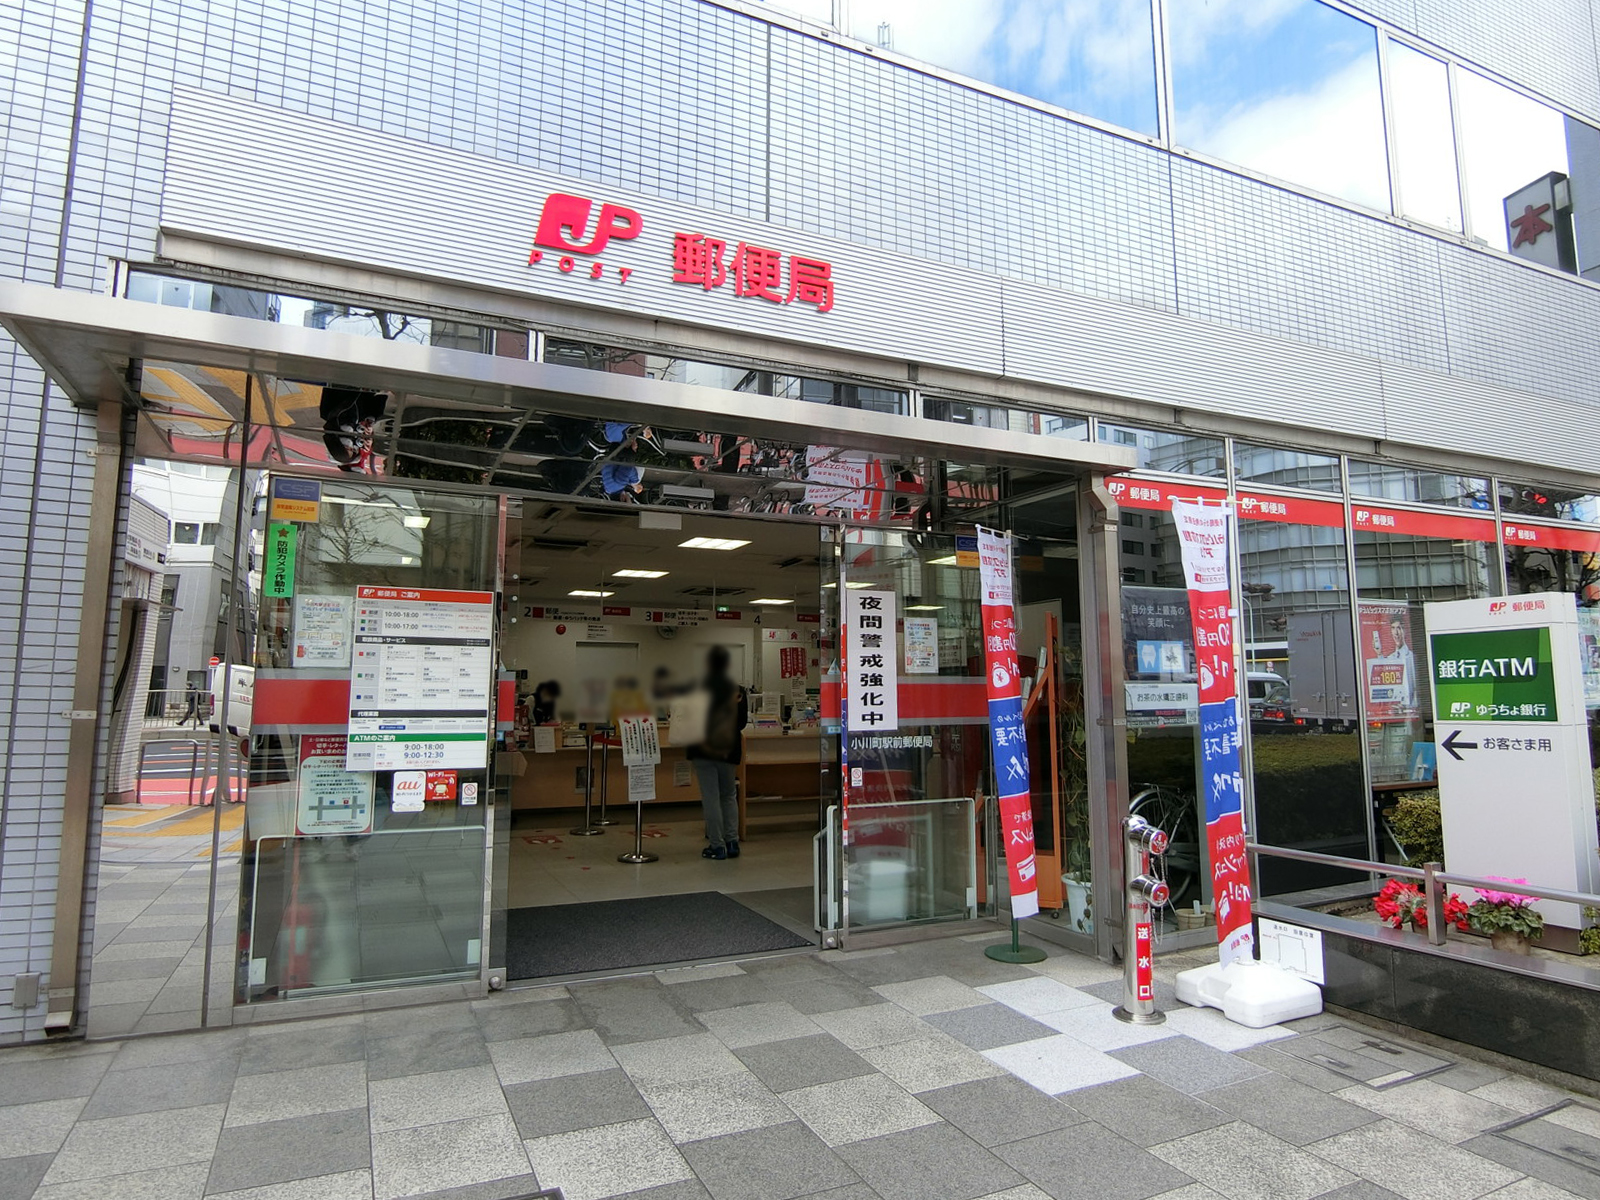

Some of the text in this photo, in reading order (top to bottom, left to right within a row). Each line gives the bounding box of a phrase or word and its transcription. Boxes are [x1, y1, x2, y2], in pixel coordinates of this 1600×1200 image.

[534, 192, 835, 313] JP 郵便局
[528, 250, 633, 283] POST
[279, 483, 316, 494] CSP
[1130, 486, 1160, 502] 郵便局
[1261, 502, 1286, 515] 郵便局
[1372, 514, 1395, 527] 郵便局
[1518, 530, 1536, 541] 郵便局
[274, 540, 288, 594] 防犯カメラ作動中
[377, 590, 397, 598] 郵便局
[400, 591, 420, 599] ご案内
[524, 606, 531, 617] 2
[1131, 604, 1185, 616] 自分史上最高の
[1489, 600, 1546, 612] JP 郵便局
[385, 611, 420, 619] 10:00-18:00
[645, 611, 652, 621] 3
[753, 615, 761, 625] 4
[1147, 617, 1175, 629] 笑顔に。
[859, 596, 884, 726] 夜間警戒強化中
[1438, 657, 1534, 679] 銀行ATM
[1450, 702, 1547, 716] JP ゆうちょ銀行
[851, 736, 933, 750] 小川町駅前郵便局
[1483, 737, 1552, 752] お客さま用
[397, 781, 421, 790] au
[1137, 926, 1151, 998] 送水口
